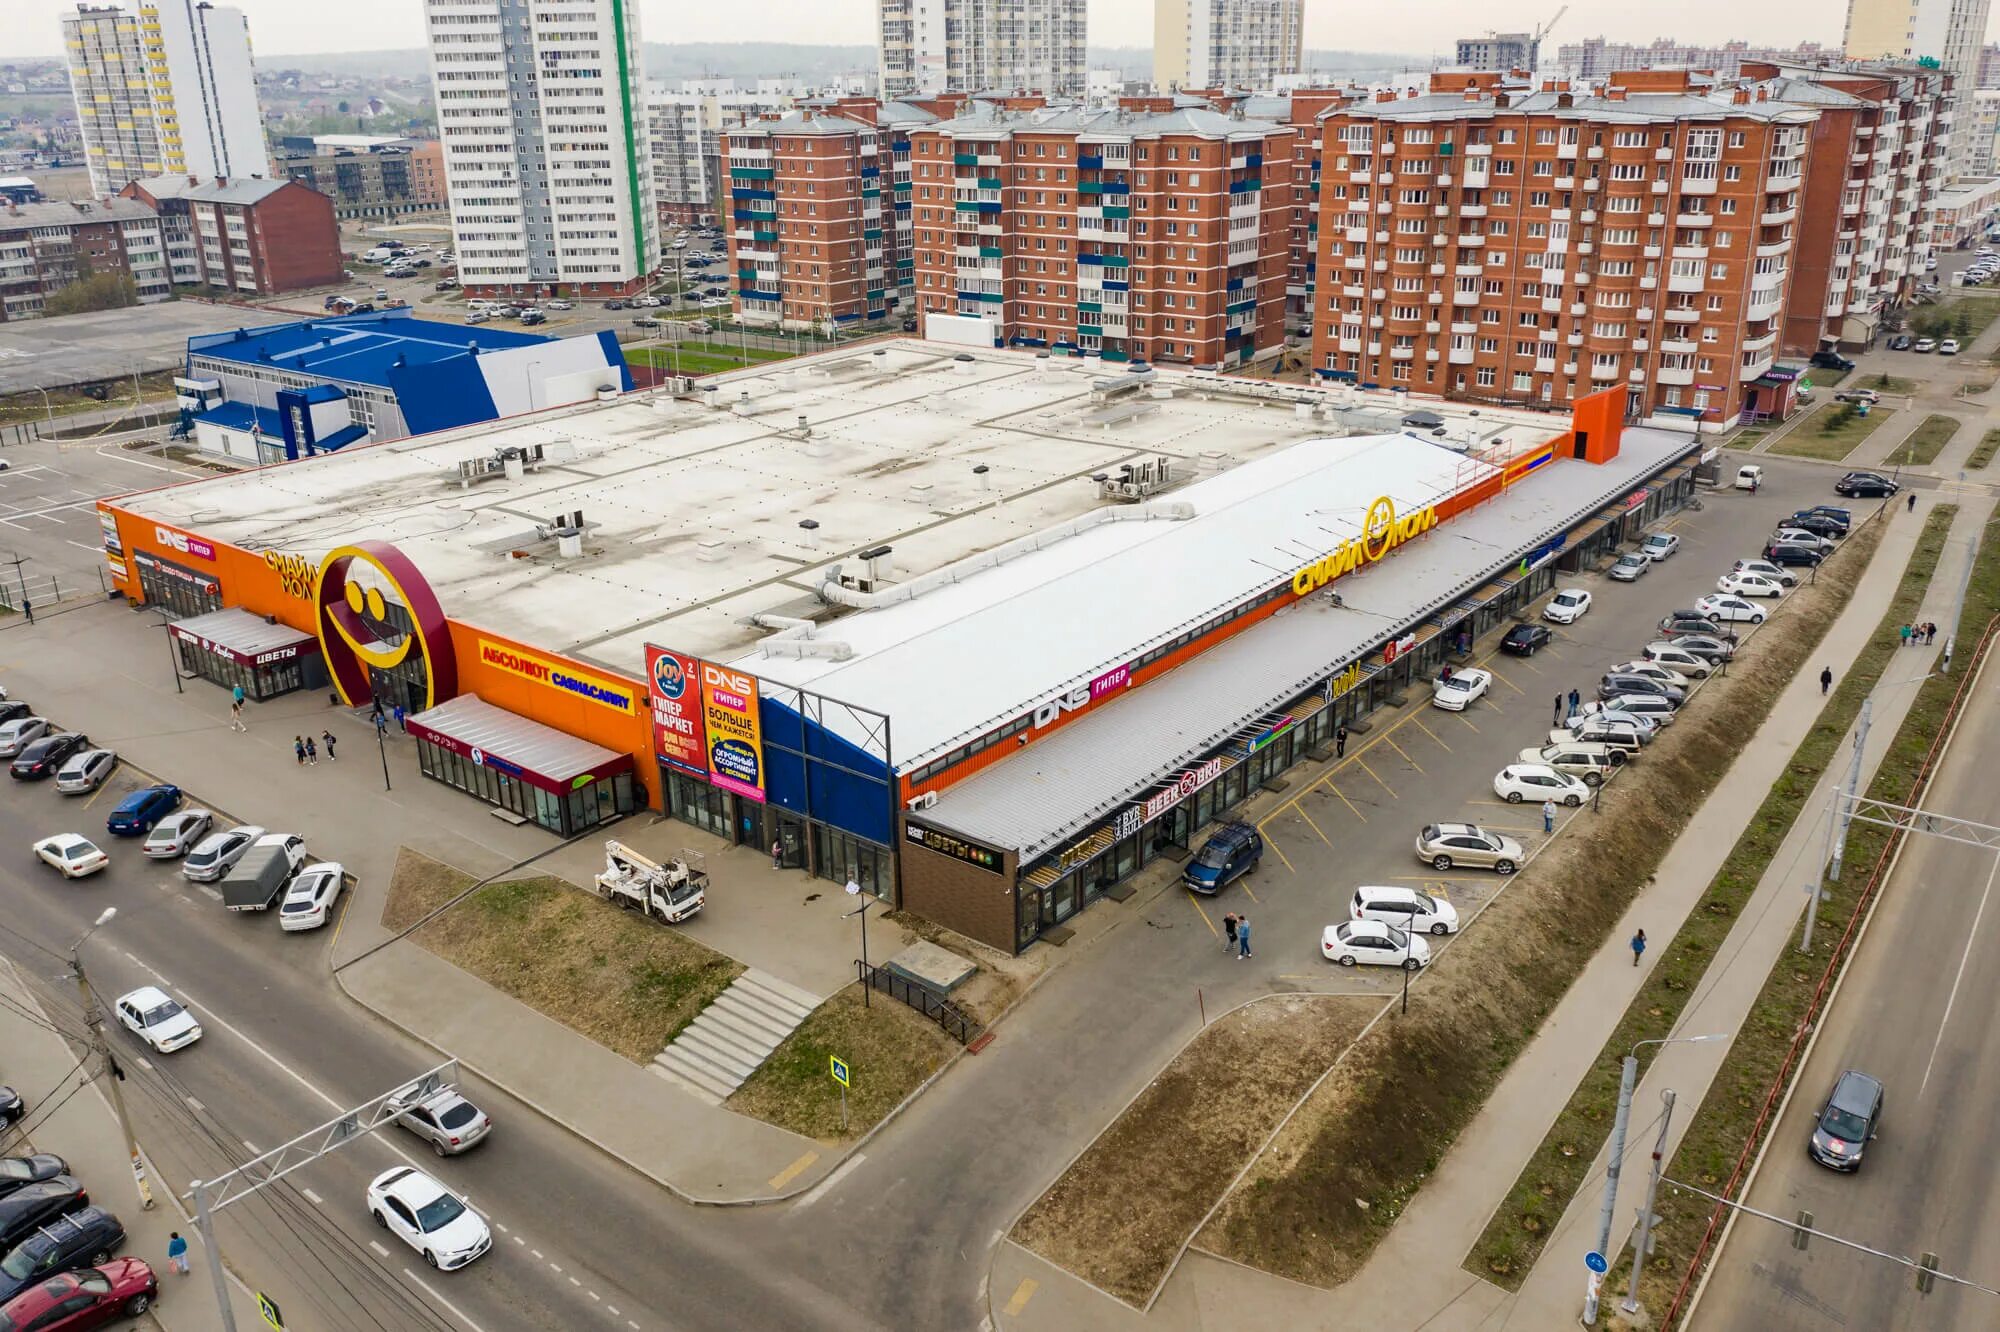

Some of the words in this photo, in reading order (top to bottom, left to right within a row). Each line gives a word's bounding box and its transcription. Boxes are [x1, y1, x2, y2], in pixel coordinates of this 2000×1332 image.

[154, 526, 189, 553] DNS
[189, 541, 211, 557] ГИПЕР
[256, 647, 297, 664] ЦВЕТЫ
[483, 646, 550, 681] АБСОЛЮТ
[656, 659, 683, 683] Joy
[705, 666, 751, 695] DNS
[1095, 669, 1126, 694] ГИПЕР
[653, 695, 682, 717] ГИПЕР
[715, 691, 744, 708] ГИПЕР
[1034, 681, 1090, 730] DNS
[655, 710, 694, 736] МАРКЕТ
[714, 756, 757, 775] АССОРТИМЕНТ
[715, 748, 754, 767] ОГРОМНЫЙ
[1147, 782, 1180, 817] BEER
[1196, 757, 1221, 785] BRO
[1122, 817, 1144, 839] BULL
[924, 830, 969, 859] ЦВЕТЫ
